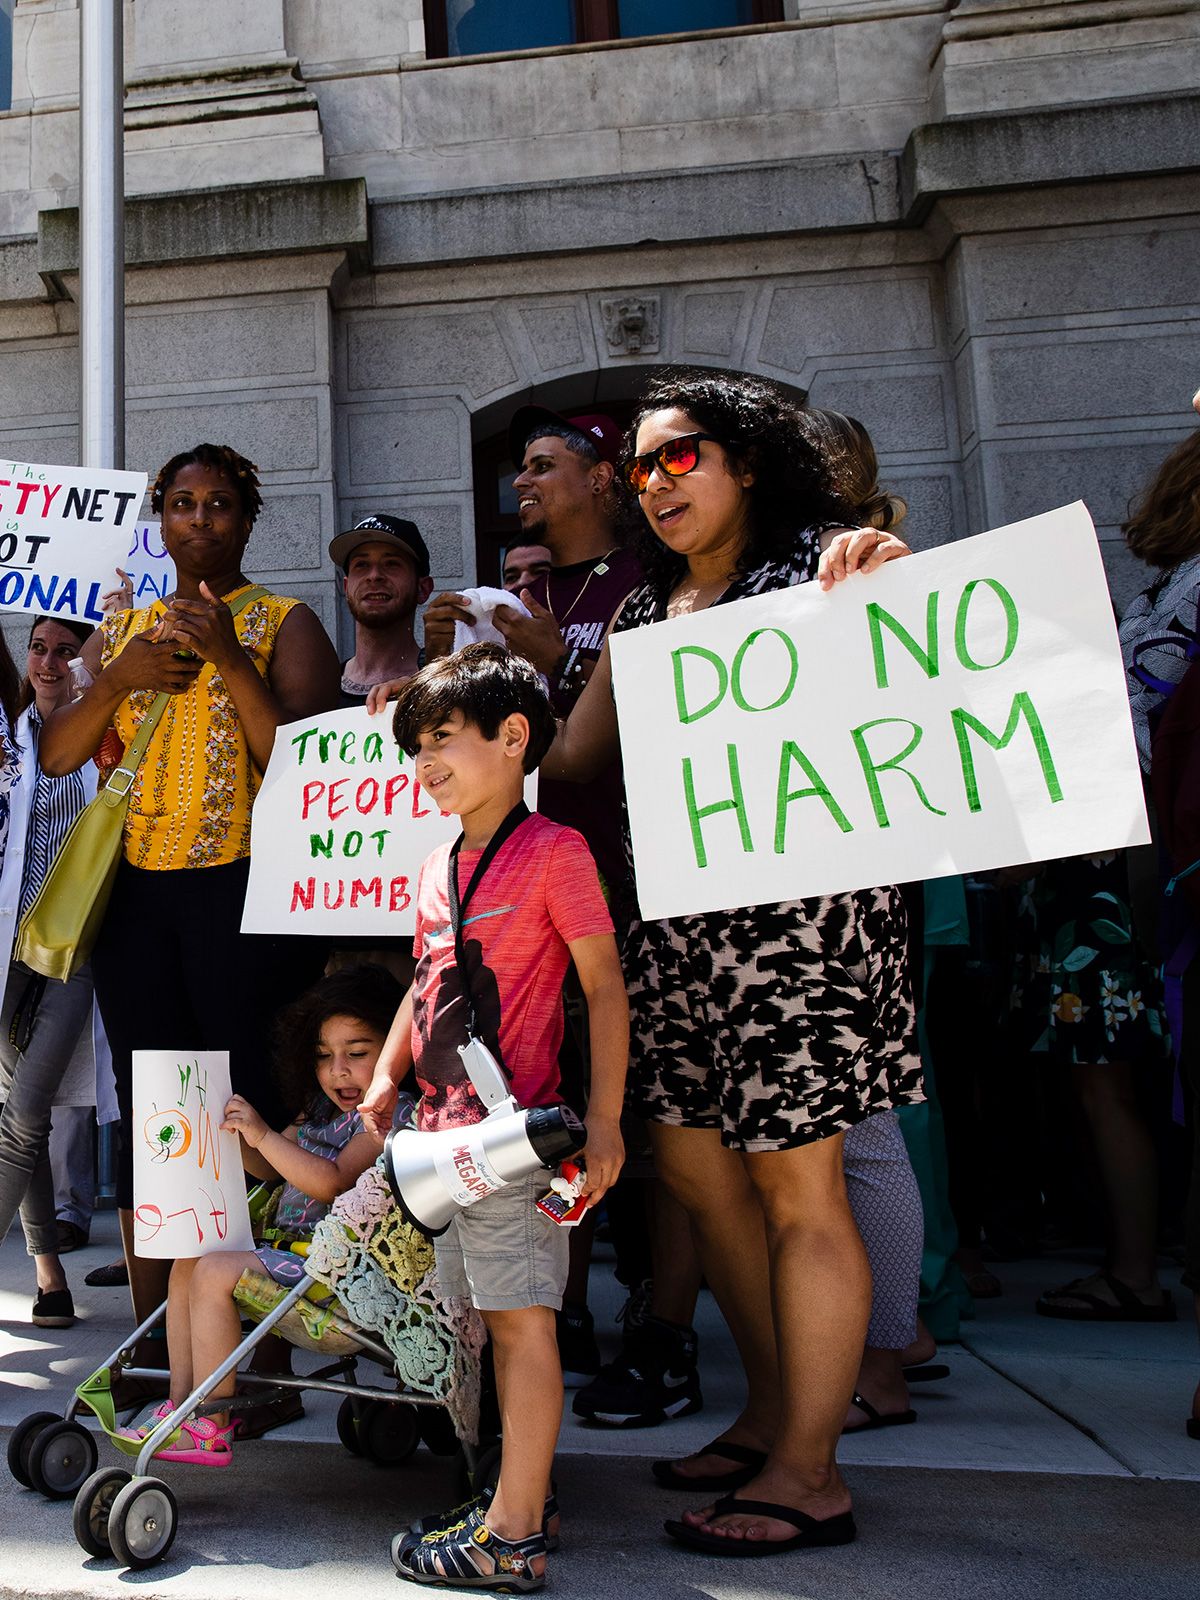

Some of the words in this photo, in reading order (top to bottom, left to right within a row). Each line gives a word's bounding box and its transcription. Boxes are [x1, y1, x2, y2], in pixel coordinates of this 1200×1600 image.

[6, 463, 47, 481] The
[62, 487, 136, 526] NET
[671, 628, 799, 724] DO
[866, 578, 1019, 689] NO
[302, 773, 452, 821] PEOPL
[682, 691, 1064, 868] HARM
[310, 829, 391, 859] NOT
[9, 1013, 21, 1043] DREXEL
